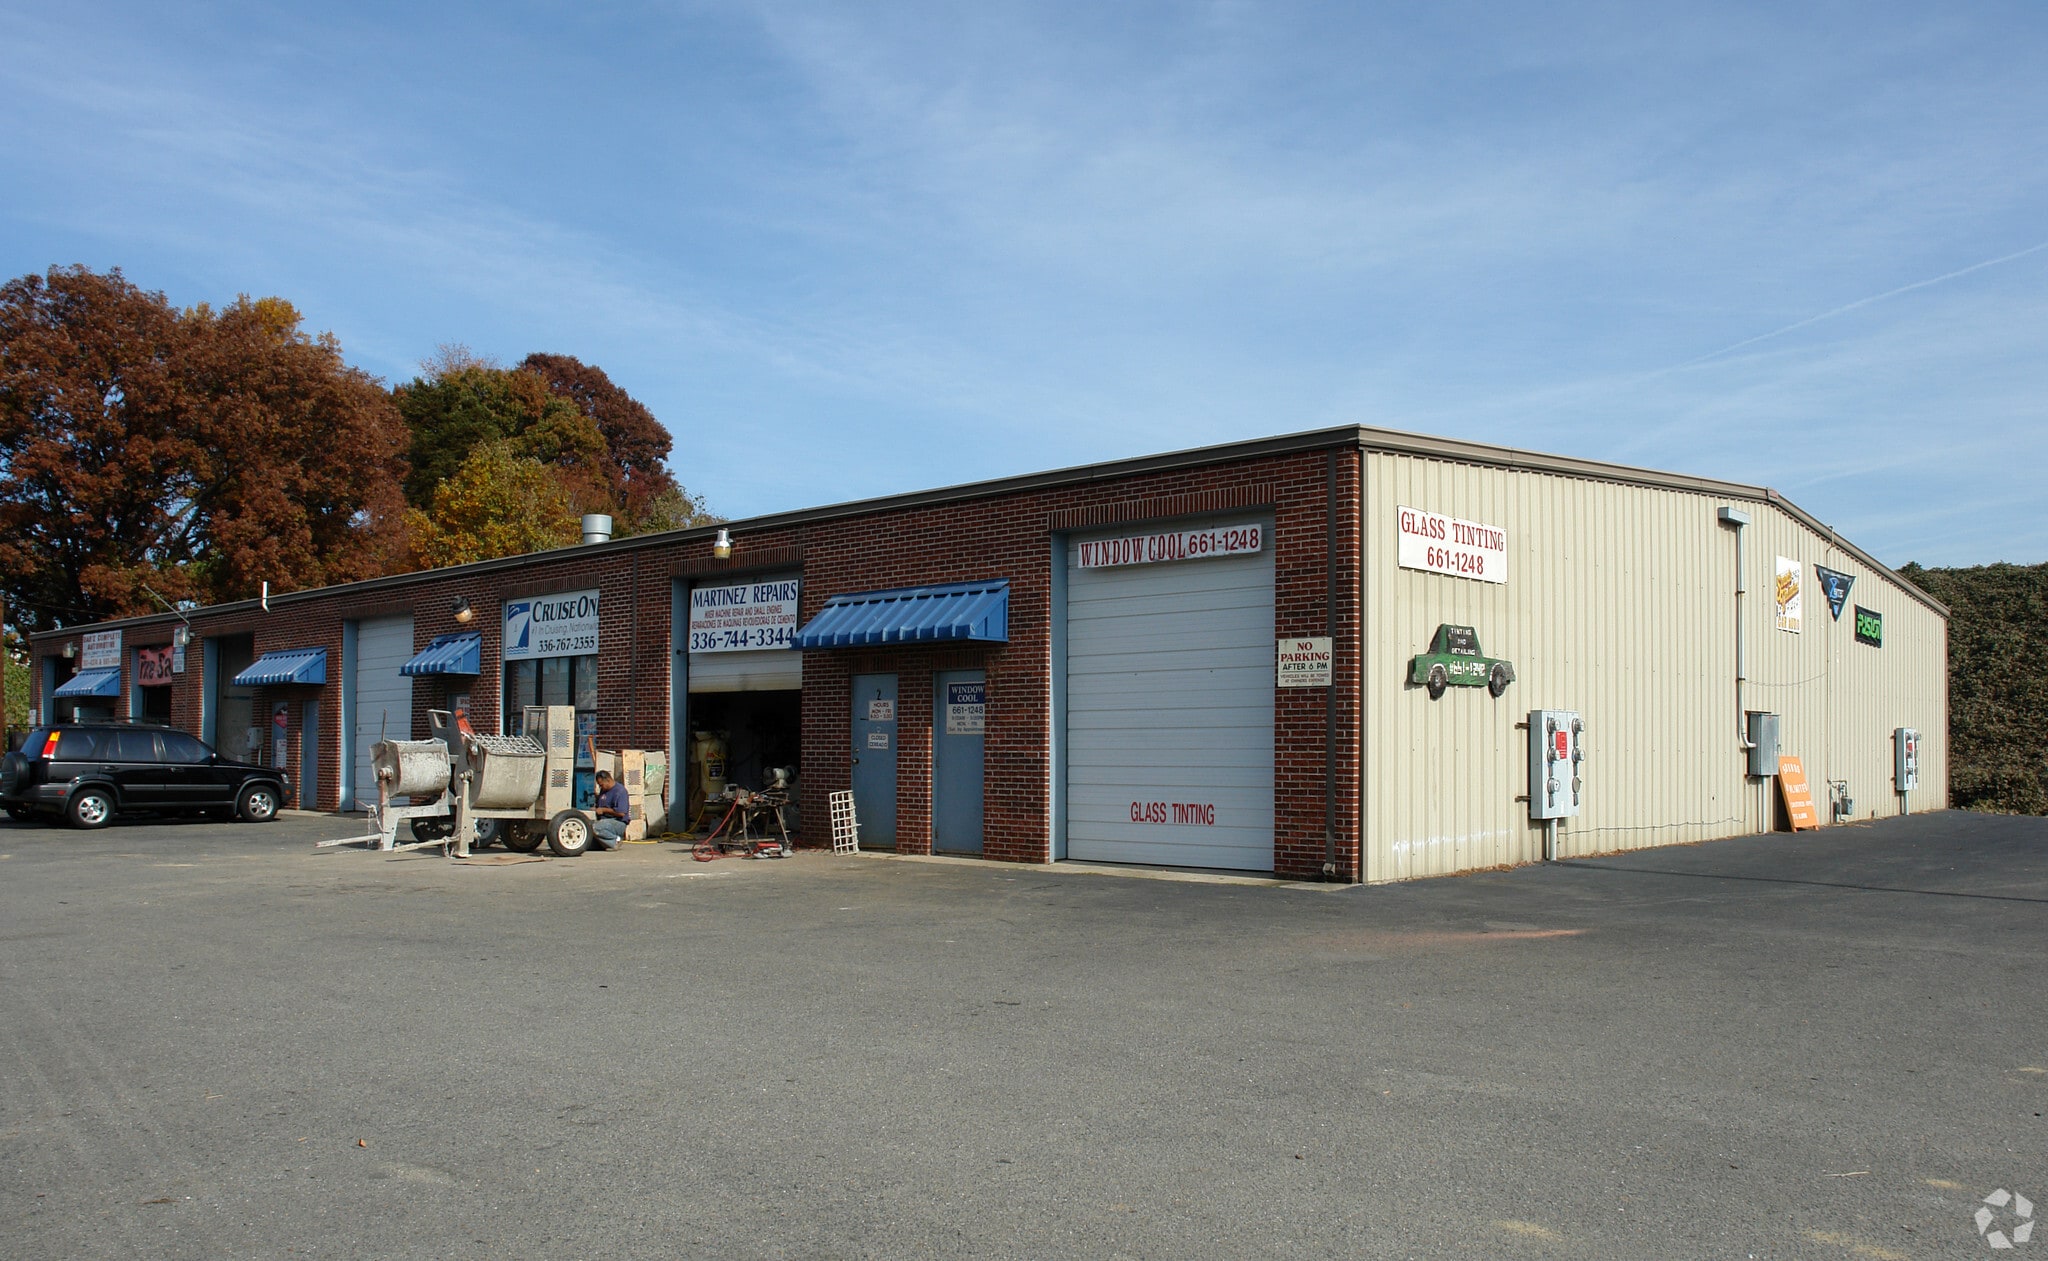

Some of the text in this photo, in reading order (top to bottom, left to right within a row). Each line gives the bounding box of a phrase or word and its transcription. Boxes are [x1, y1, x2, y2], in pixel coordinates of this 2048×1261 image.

[1401, 511, 1504, 552] GLASS TINTING
[1080, 528, 1259, 566] WINDOW COOL 661-1248
[693, 582, 796, 608] MARTINEZ REPAIRS
[745, 607, 753, 616] AND
[538, 636, 594, 652] 336-767-2355
[691, 627, 794, 650] 336-744-3344
[1297, 642, 1312, 651] NO
[1281, 652, 1330, 662] PARKING
[877, 688, 881, 700] 2
[952, 686, 984, 694] WINDOW
[952, 706, 983, 714] 661-1248
[1131, 802, 1214, 825] GLASS TINTING
